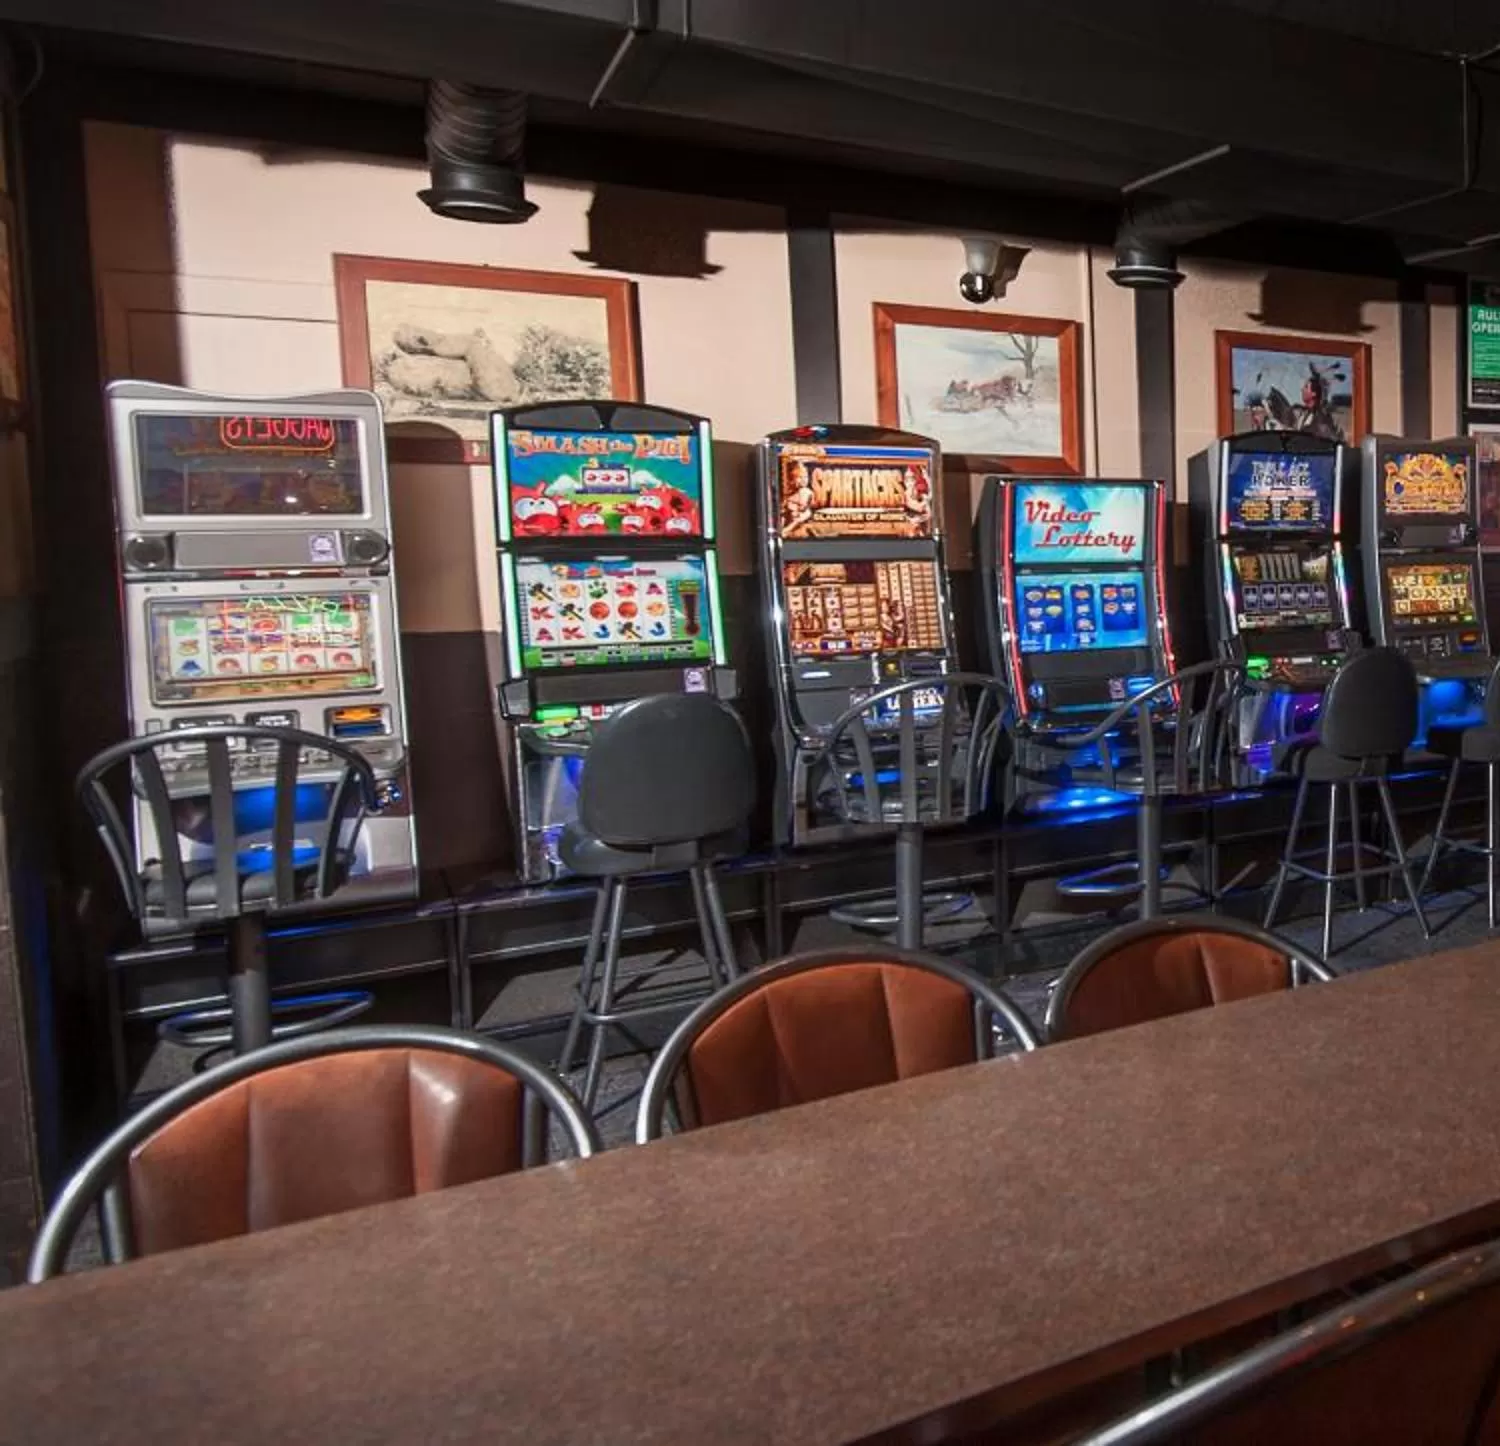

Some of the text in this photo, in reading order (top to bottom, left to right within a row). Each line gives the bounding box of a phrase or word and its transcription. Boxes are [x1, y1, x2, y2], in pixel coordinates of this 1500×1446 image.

[511, 430, 609, 457] SMASH
[1023, 499, 1102, 524] Video
[1034, 525, 1136, 553] Lottery
